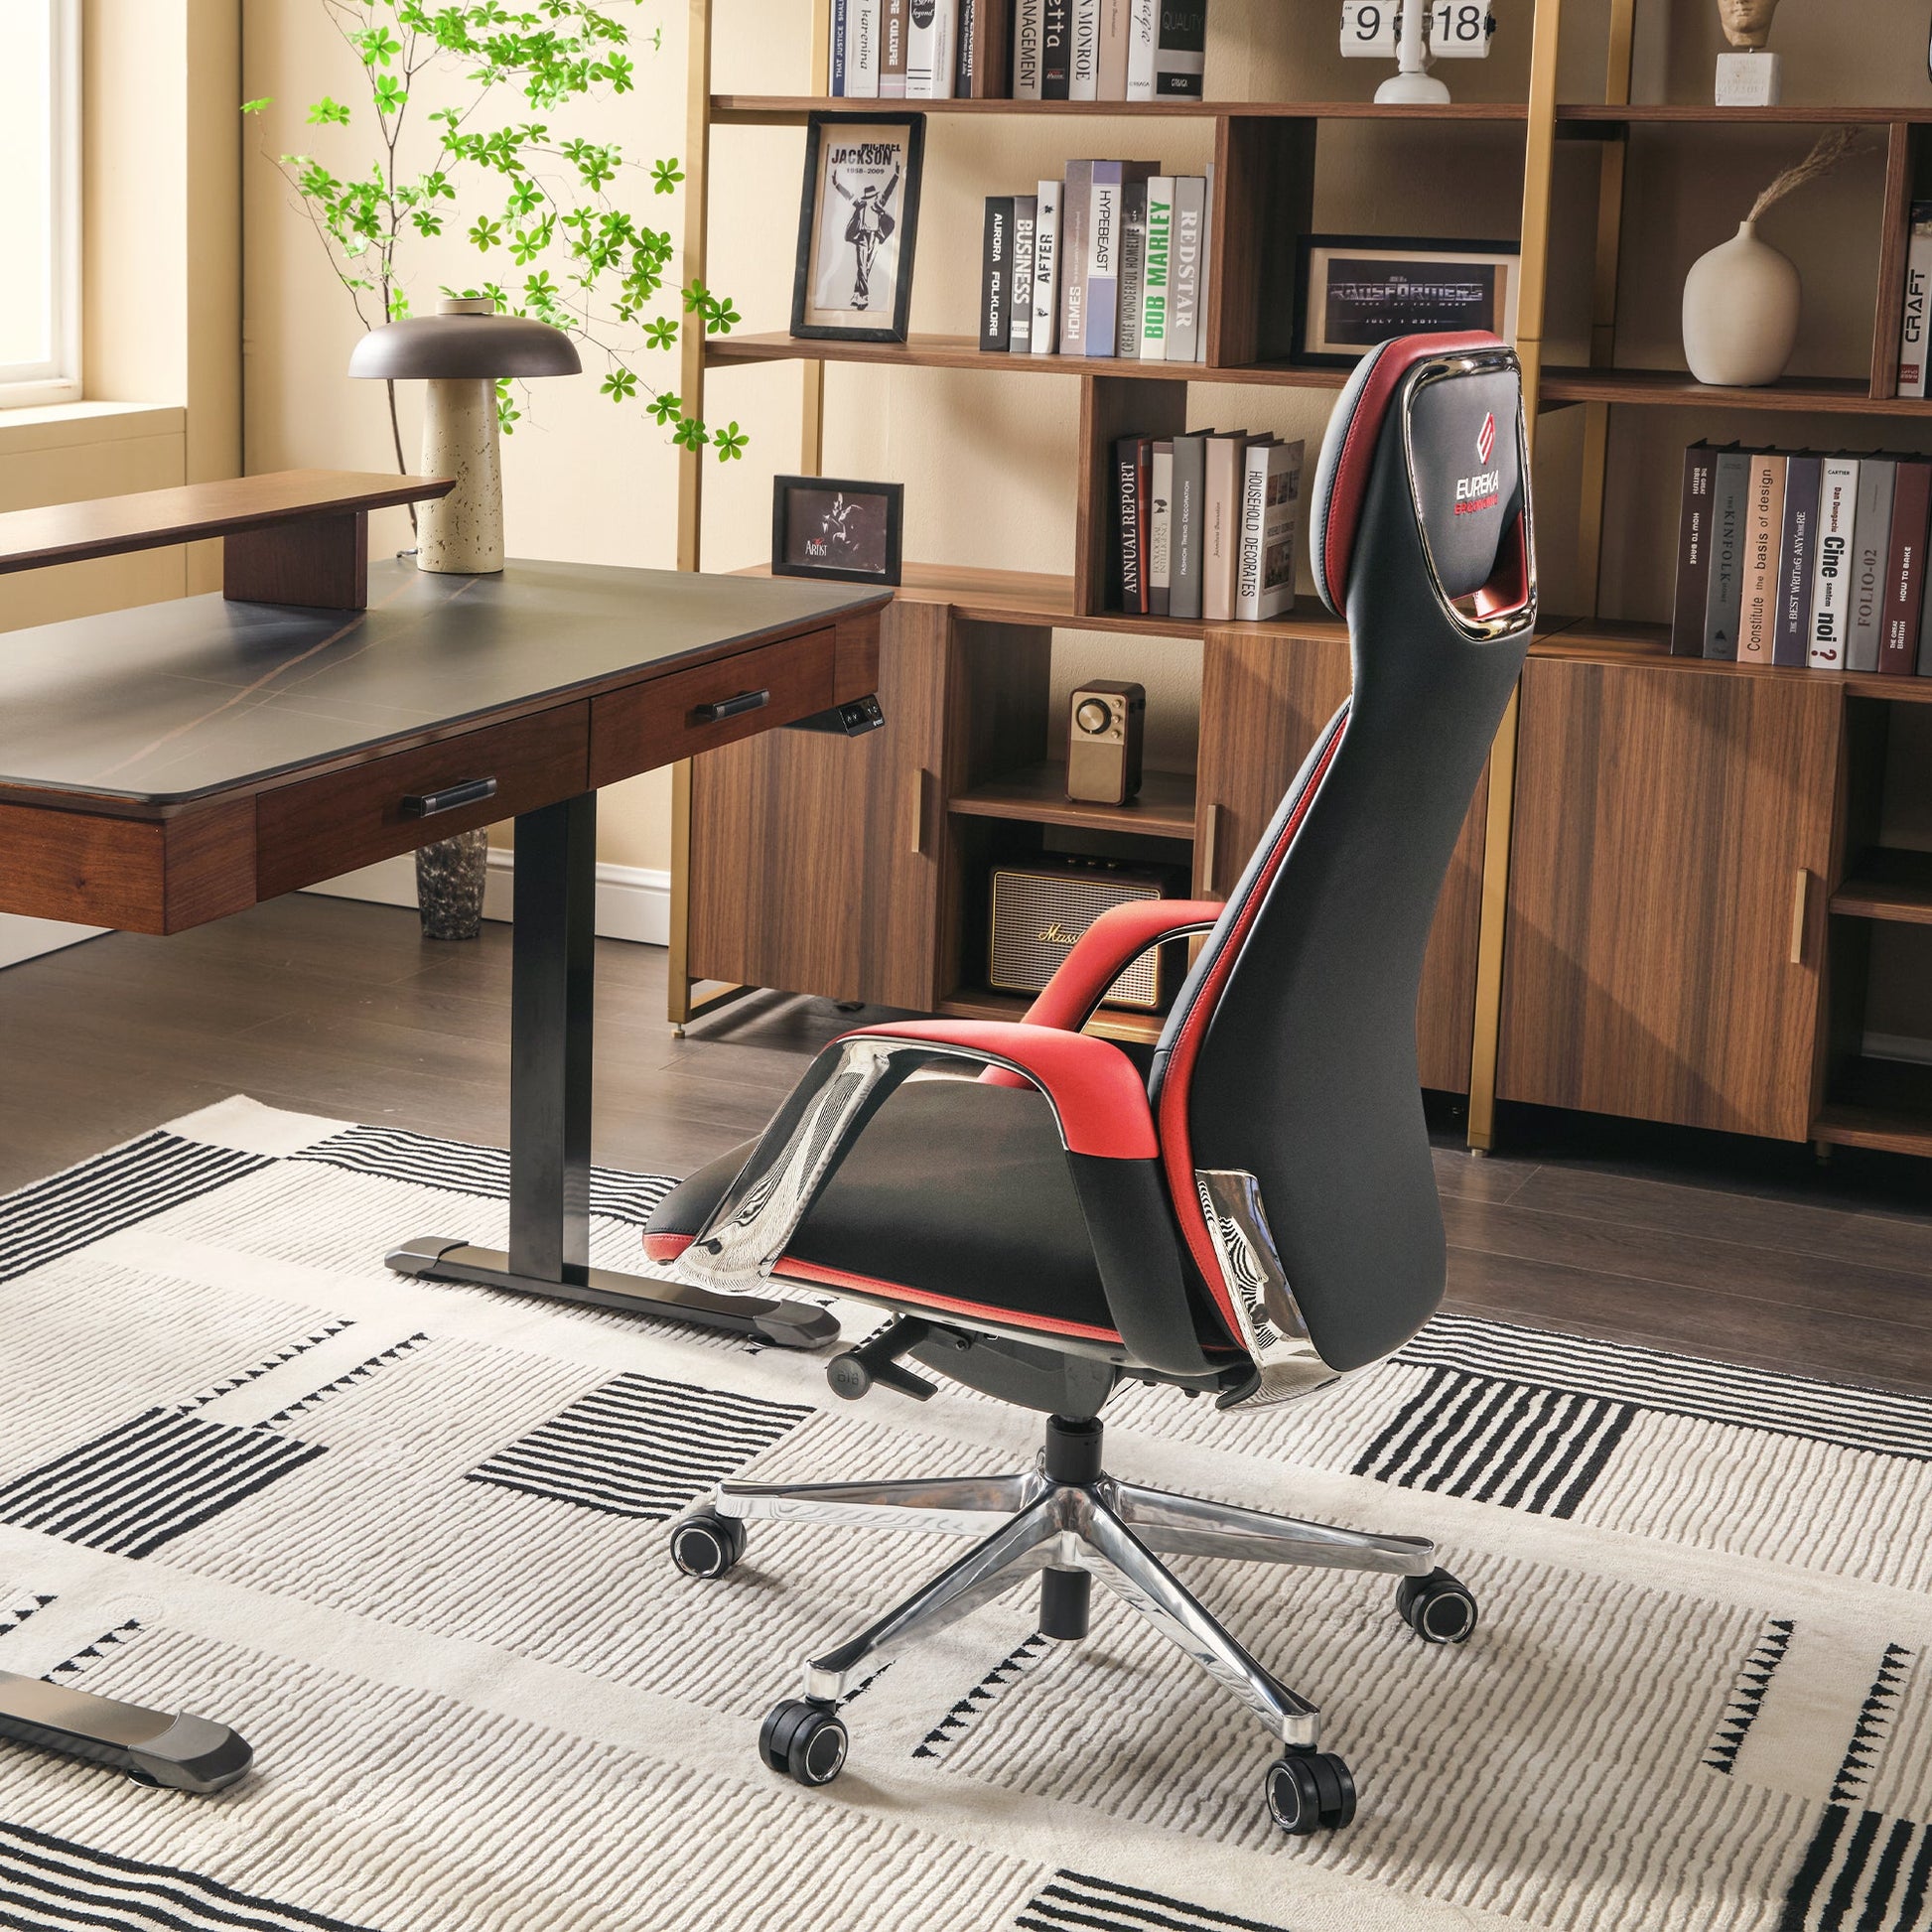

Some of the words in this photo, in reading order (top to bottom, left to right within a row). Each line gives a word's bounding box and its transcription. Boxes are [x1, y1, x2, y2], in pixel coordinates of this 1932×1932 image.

[860, 9, 871, 69] karenina
[889, 19, 898, 66] CULTURE
[1076, 12, 1093, 80] MONROE
[1356, 5, 1380, 41] 9
[1438, 5, 1479, 42] 18
[832, 149, 892, 166] JACKSON
[993, 212, 1003, 262] AURORA
[1096, 190, 1112, 272] HYPEBEAST
[1126, 228, 1141, 269] HOMELIFE
[1147, 201, 1171, 286] MARLEY
[1014, 218, 1034, 305] BUSINESS
[1037, 233, 1053, 284] AFTER
[1175, 210, 1198, 328] REDSTAR
[989, 271, 1000, 337] FOLKLORE
[1067, 286, 1081, 340] HOMES
[1123, 271, 1138, 322] WONDERFUL
[1144, 295, 1166, 339] BOB
[1329, 284, 1483, 301] RANSFORMERS
[1904, 269, 1925, 343] CRAFT
[1122, 323, 1136, 352] CREATE
[1121, 462, 1136, 526] REPORT
[1245, 471, 1263, 531] HOUSEHOLD
[1456, 470, 1499, 500] EUREKA
[1757, 469, 1773, 512] design
[1692, 533, 1698, 542] TO
[1721, 510, 1734, 582] KINFOLK
[1759, 516, 1768, 527] of
[1123, 528, 1137, 594] ANNUAL
[1241, 537, 1259, 598] DECORATES
[1754, 533, 1768, 569] basis
[1822, 536, 1845, 578] Cine
[1902, 571, 1909, 581] TO
[1755, 575, 1764, 590] the
[1857, 548, 1877, 627] FOLIO-02
[1899, 582, 1908, 602] HOW
[1747, 597, 1764, 651] Constitute
[1789, 595, 1799, 621] BEST
[1817, 612, 1837, 642] noi
